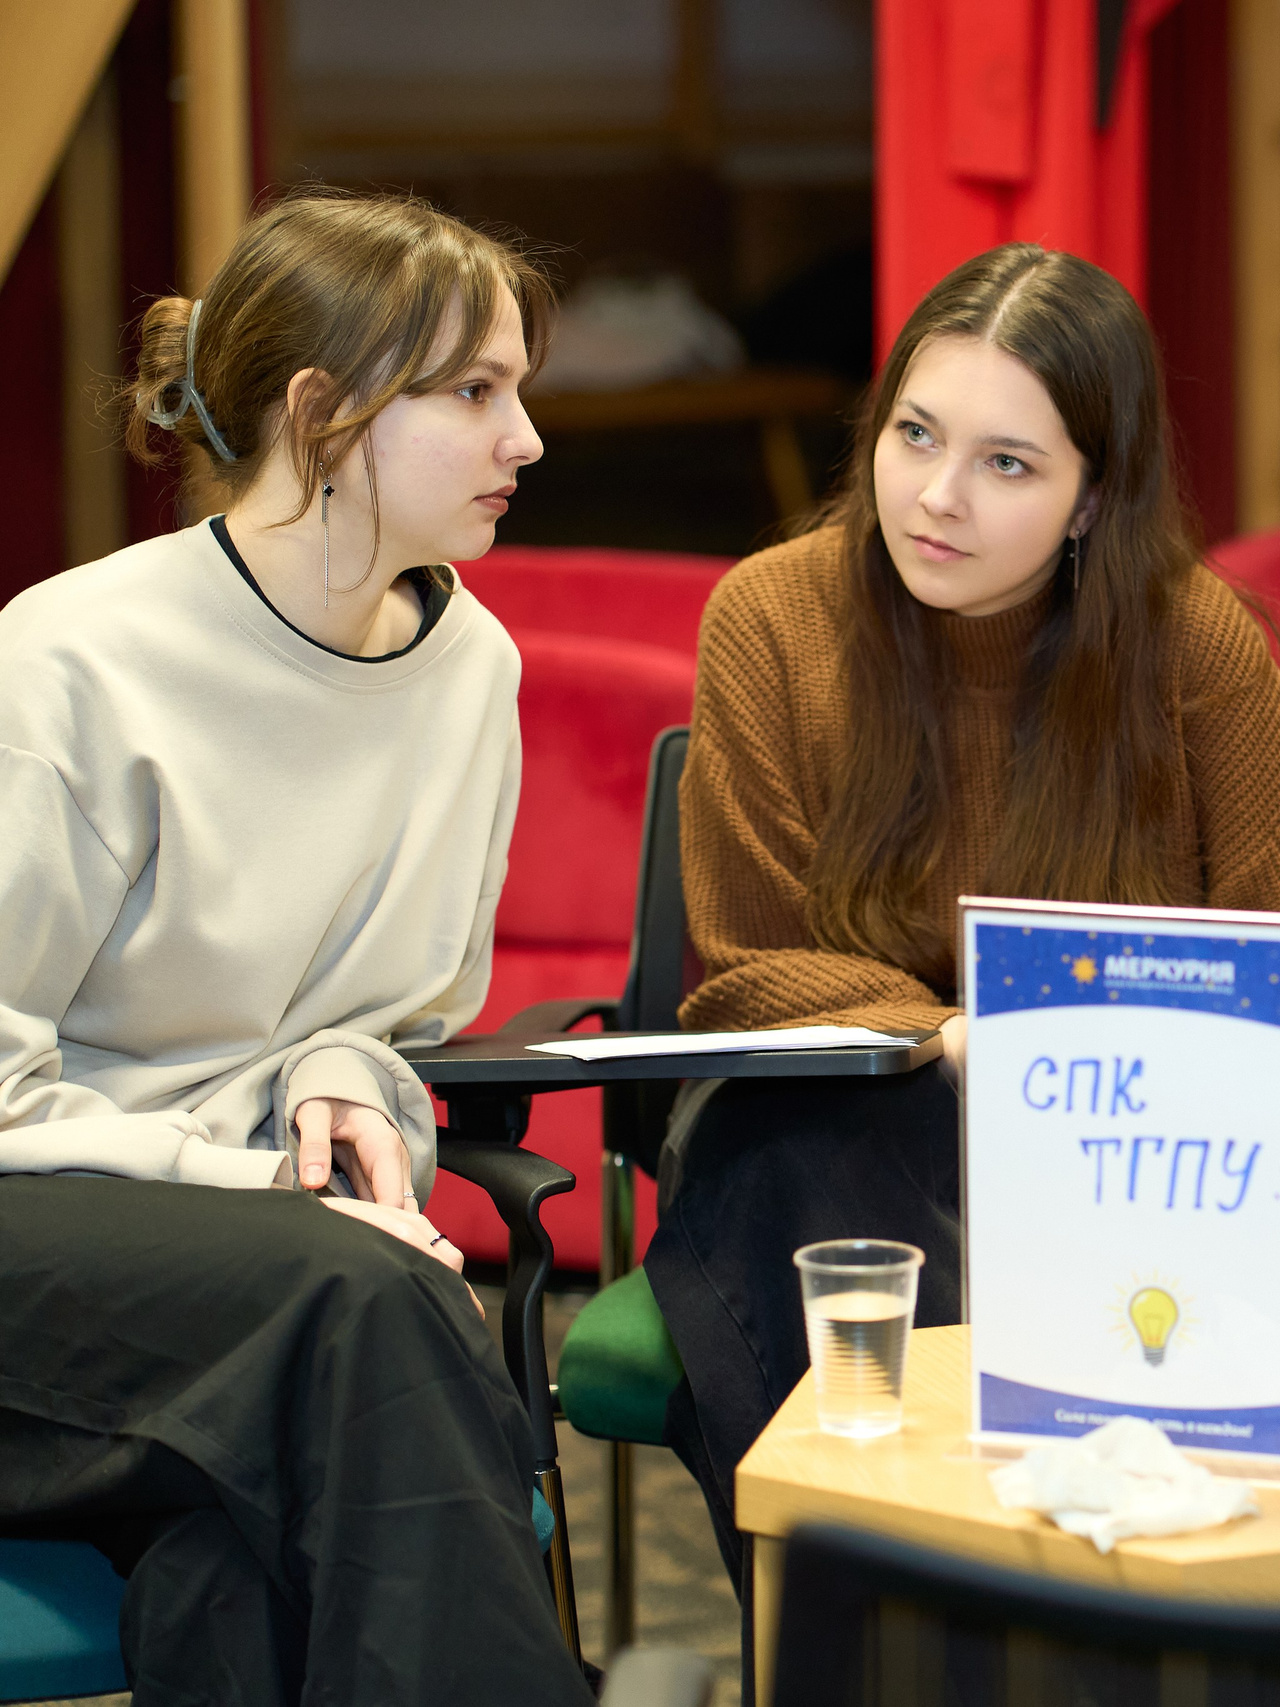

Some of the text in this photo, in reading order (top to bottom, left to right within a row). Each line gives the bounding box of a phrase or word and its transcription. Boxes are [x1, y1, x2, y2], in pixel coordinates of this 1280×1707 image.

[1103, 955, 1236, 985] МЕРКУРИЯ
[1022, 1055, 1148, 1117] СПК
[1079, 1136, 1262, 1213] ТГПУ
